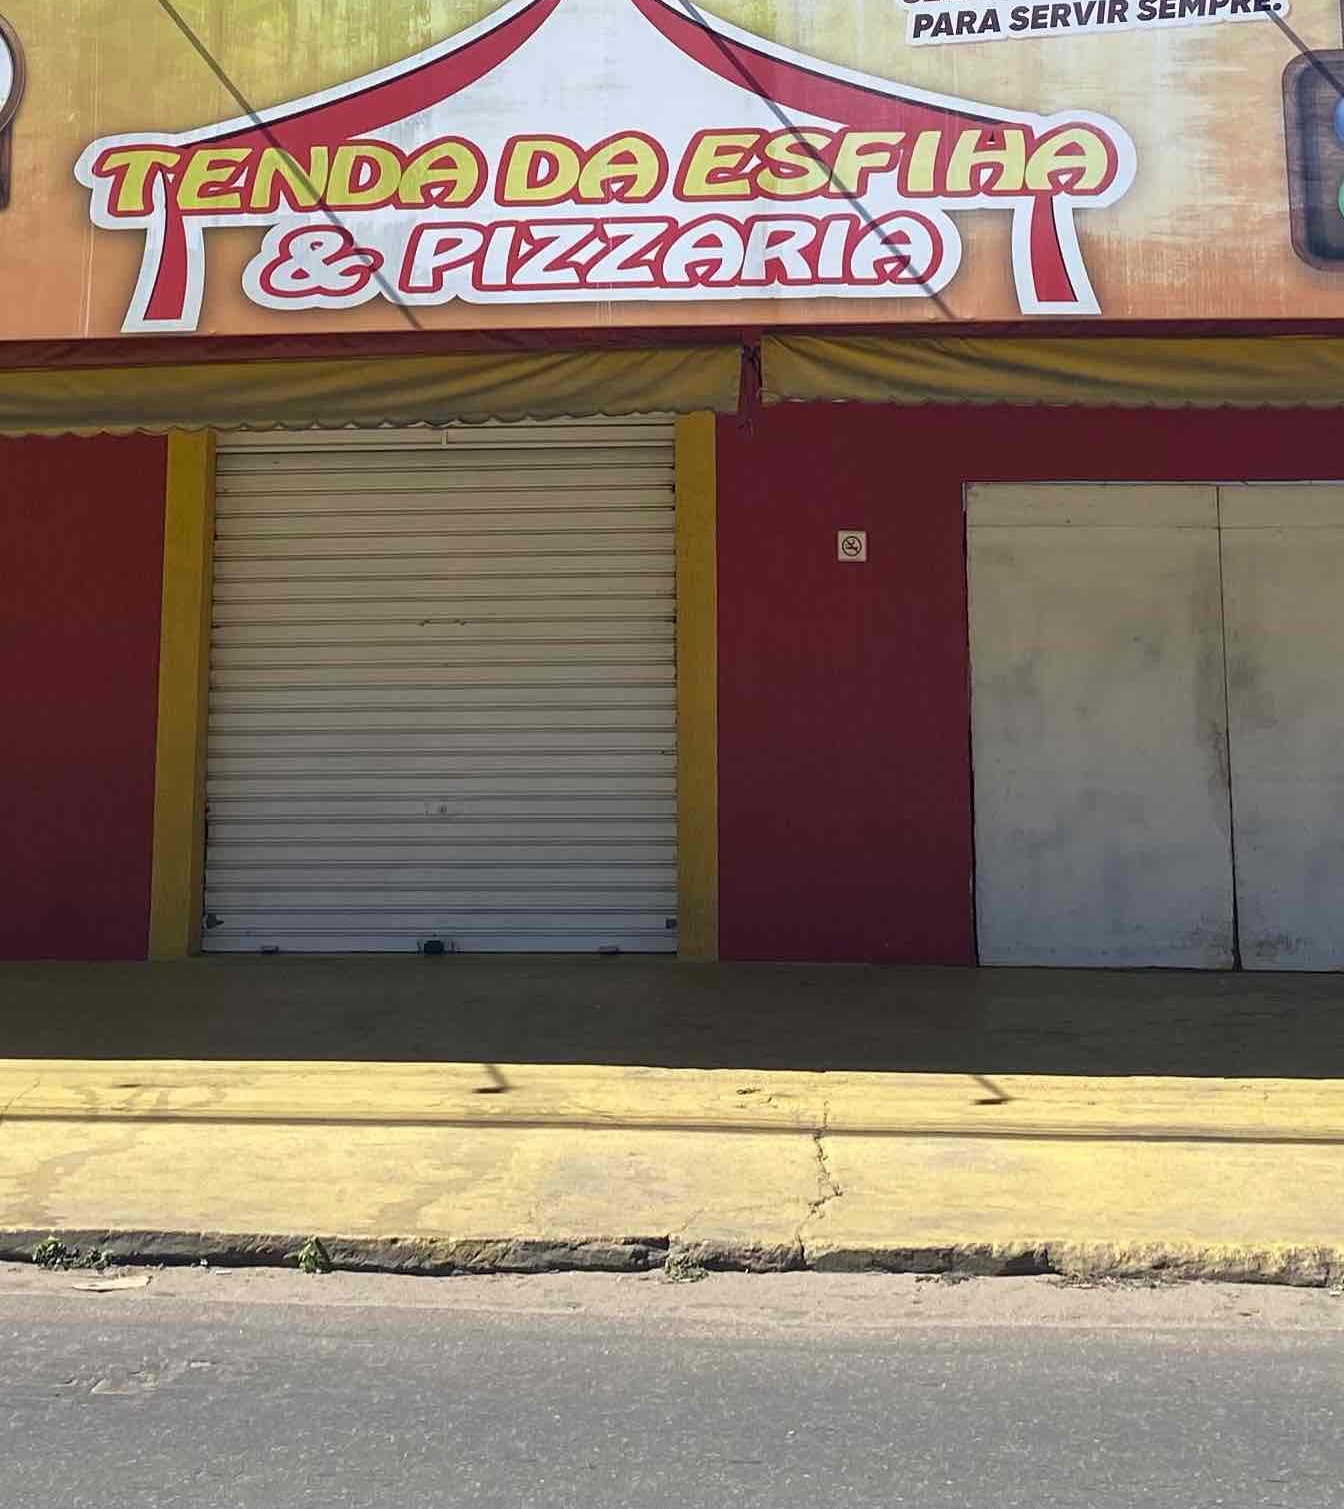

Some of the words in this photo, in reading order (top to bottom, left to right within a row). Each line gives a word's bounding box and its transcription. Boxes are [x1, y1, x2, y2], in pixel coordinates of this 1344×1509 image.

[912, 8, 1002, 39] PARA
[94, 138, 487, 213] TENDA
[496, 133, 670, 207] DA
[678, 125, 1118, 202] ESFIHA
[264, 226, 379, 296] &
[401, 213, 946, 293] PIZZARIA
